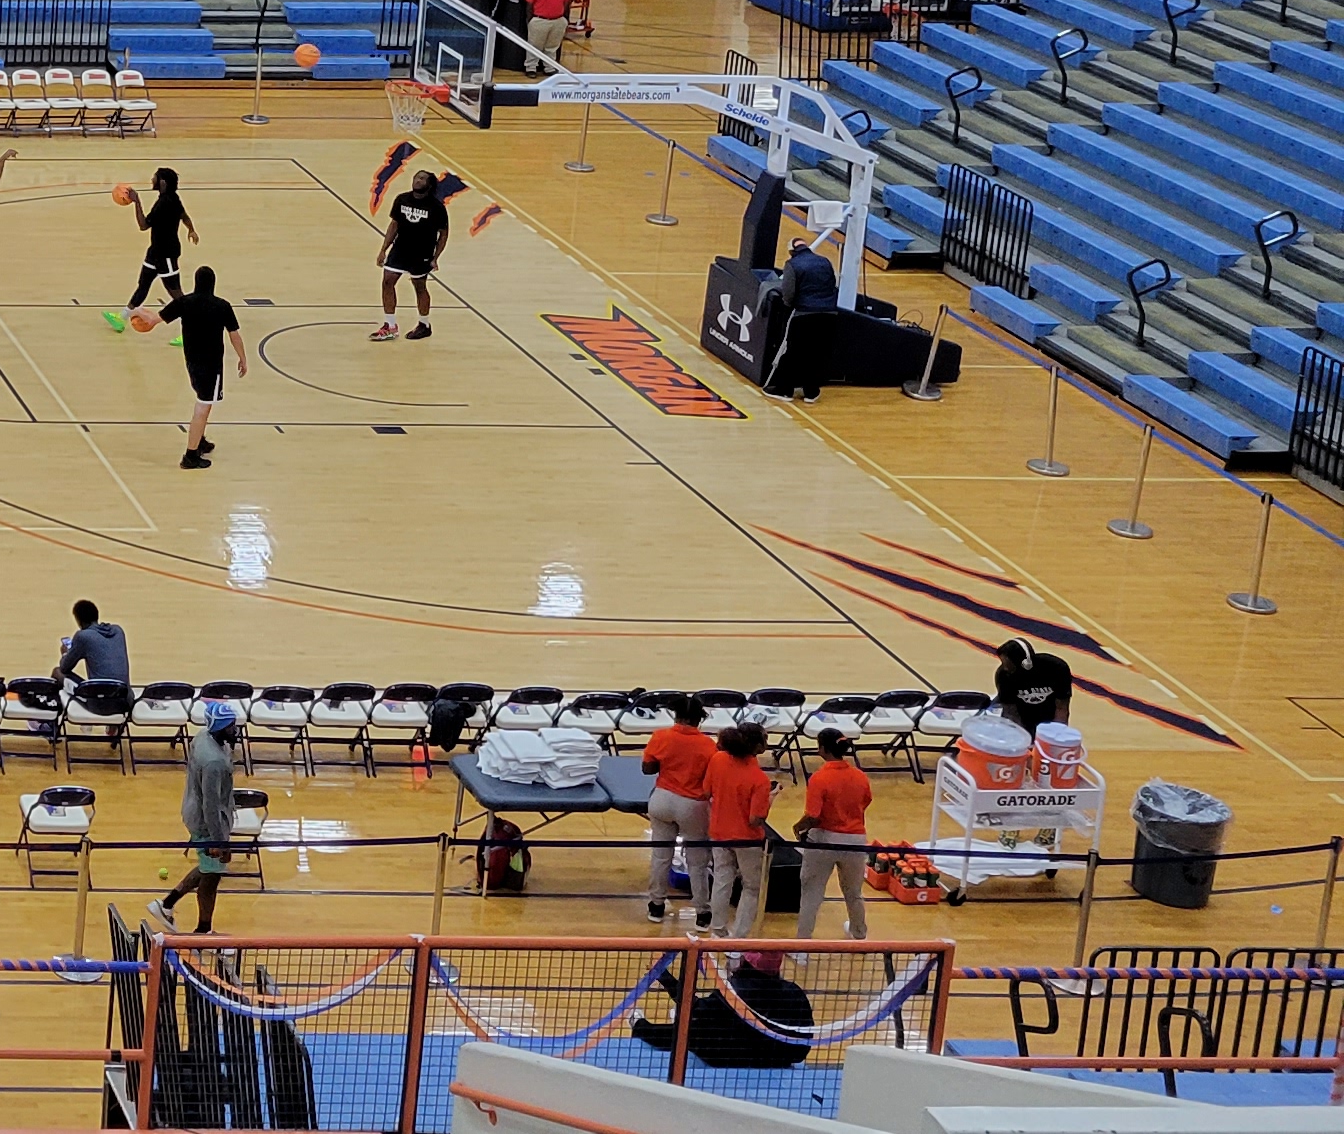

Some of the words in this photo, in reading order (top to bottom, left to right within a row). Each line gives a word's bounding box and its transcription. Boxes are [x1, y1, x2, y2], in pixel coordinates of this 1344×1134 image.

[551, 89, 671, 103] www.morganstatebears.com
[724, 103, 770, 126] Schelde
[709, 326, 729, 346] UNDER
[728, 341, 754, 363] ARMOUR
[545, 313, 744, 419] MORGAN
[943, 775, 969, 801] GATORADE
[996, 795, 1077, 807] GATORADE
[916, 891, 928, 902] G
